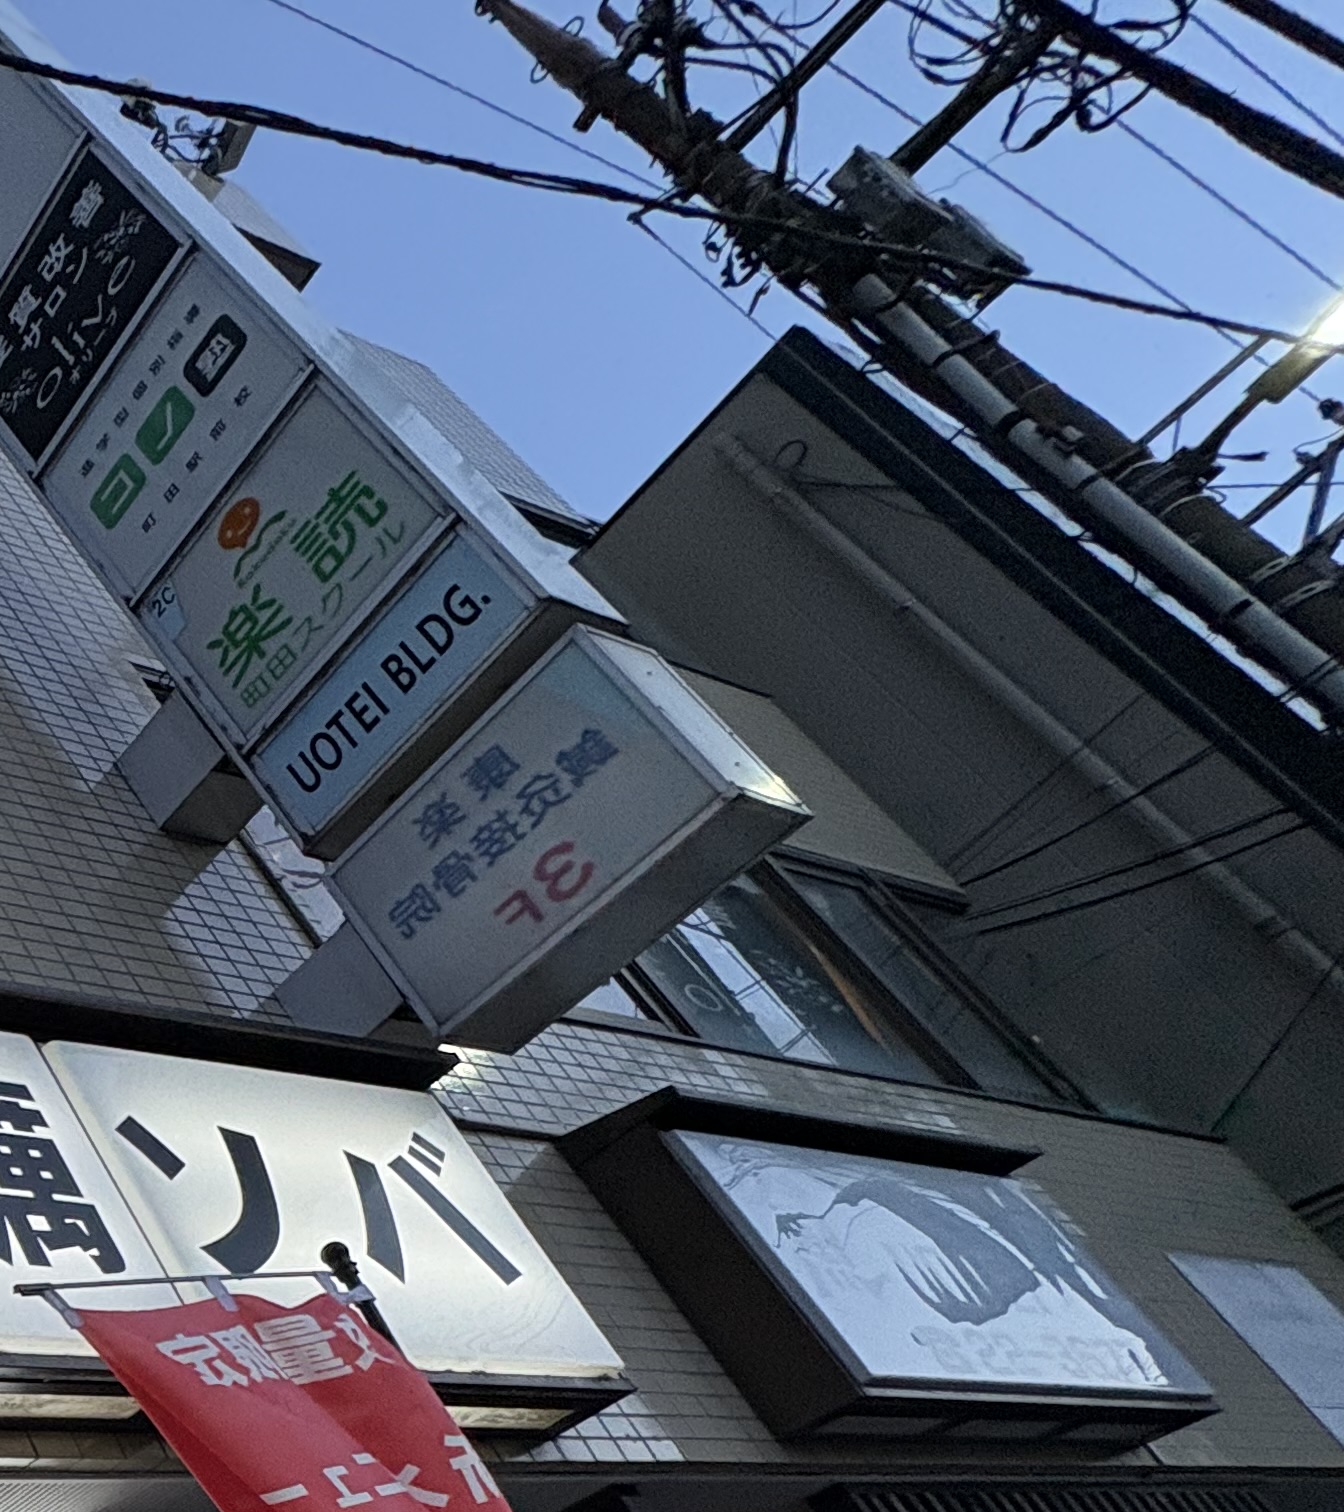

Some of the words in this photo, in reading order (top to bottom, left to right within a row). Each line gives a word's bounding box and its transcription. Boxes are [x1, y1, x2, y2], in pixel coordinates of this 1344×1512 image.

[20, 247, 88, 351] サロン
[141, 385, 253, 533] 町田駅前校
[151, 586, 178, 618] 2C
[240, 520, 407, 709] 町田スクール
[286, 681, 390, 793] UOTEI
[380, 584, 492, 695] BLDG.
